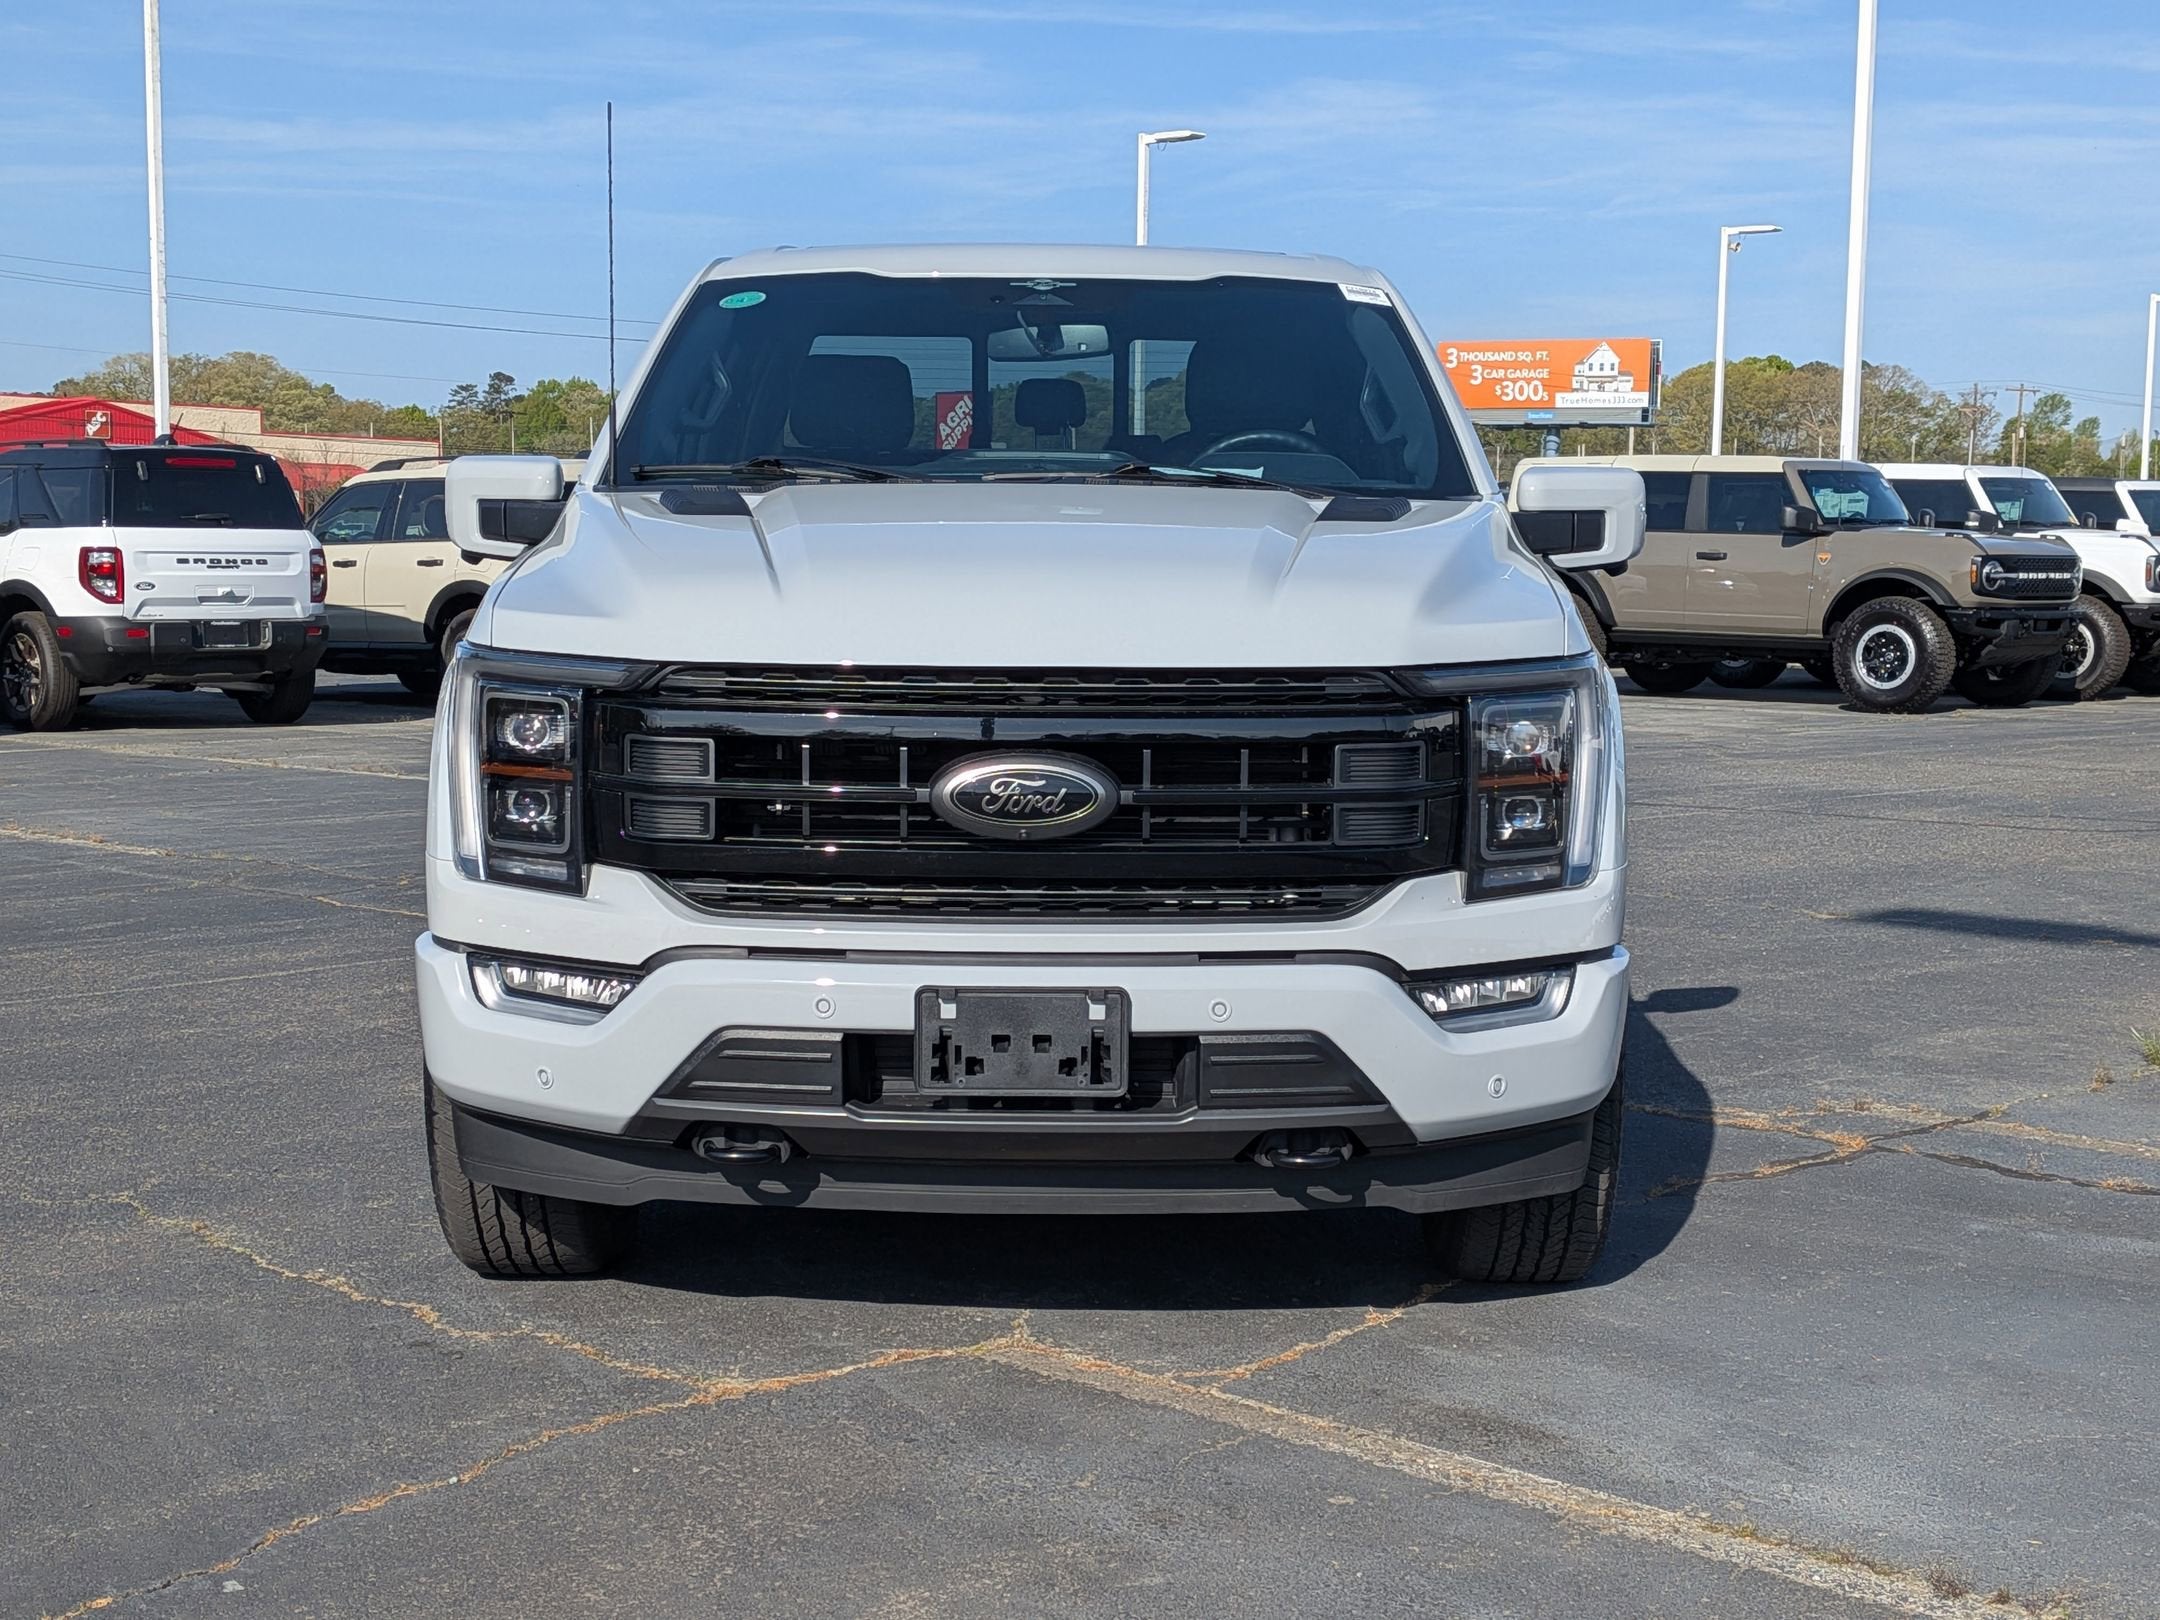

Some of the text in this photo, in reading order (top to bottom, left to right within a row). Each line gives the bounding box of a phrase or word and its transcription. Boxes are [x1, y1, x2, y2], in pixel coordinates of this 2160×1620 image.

[1446, 347, 1550, 369] 3 THOUSAND SQ. FT.
[1470, 364, 1550, 385] 3 CAR GARAGE
[176, 558, 268, 566] BRONCO
[2018, 572, 2072, 580] BRONCO
[981, 777, 1068, 814] Ford
